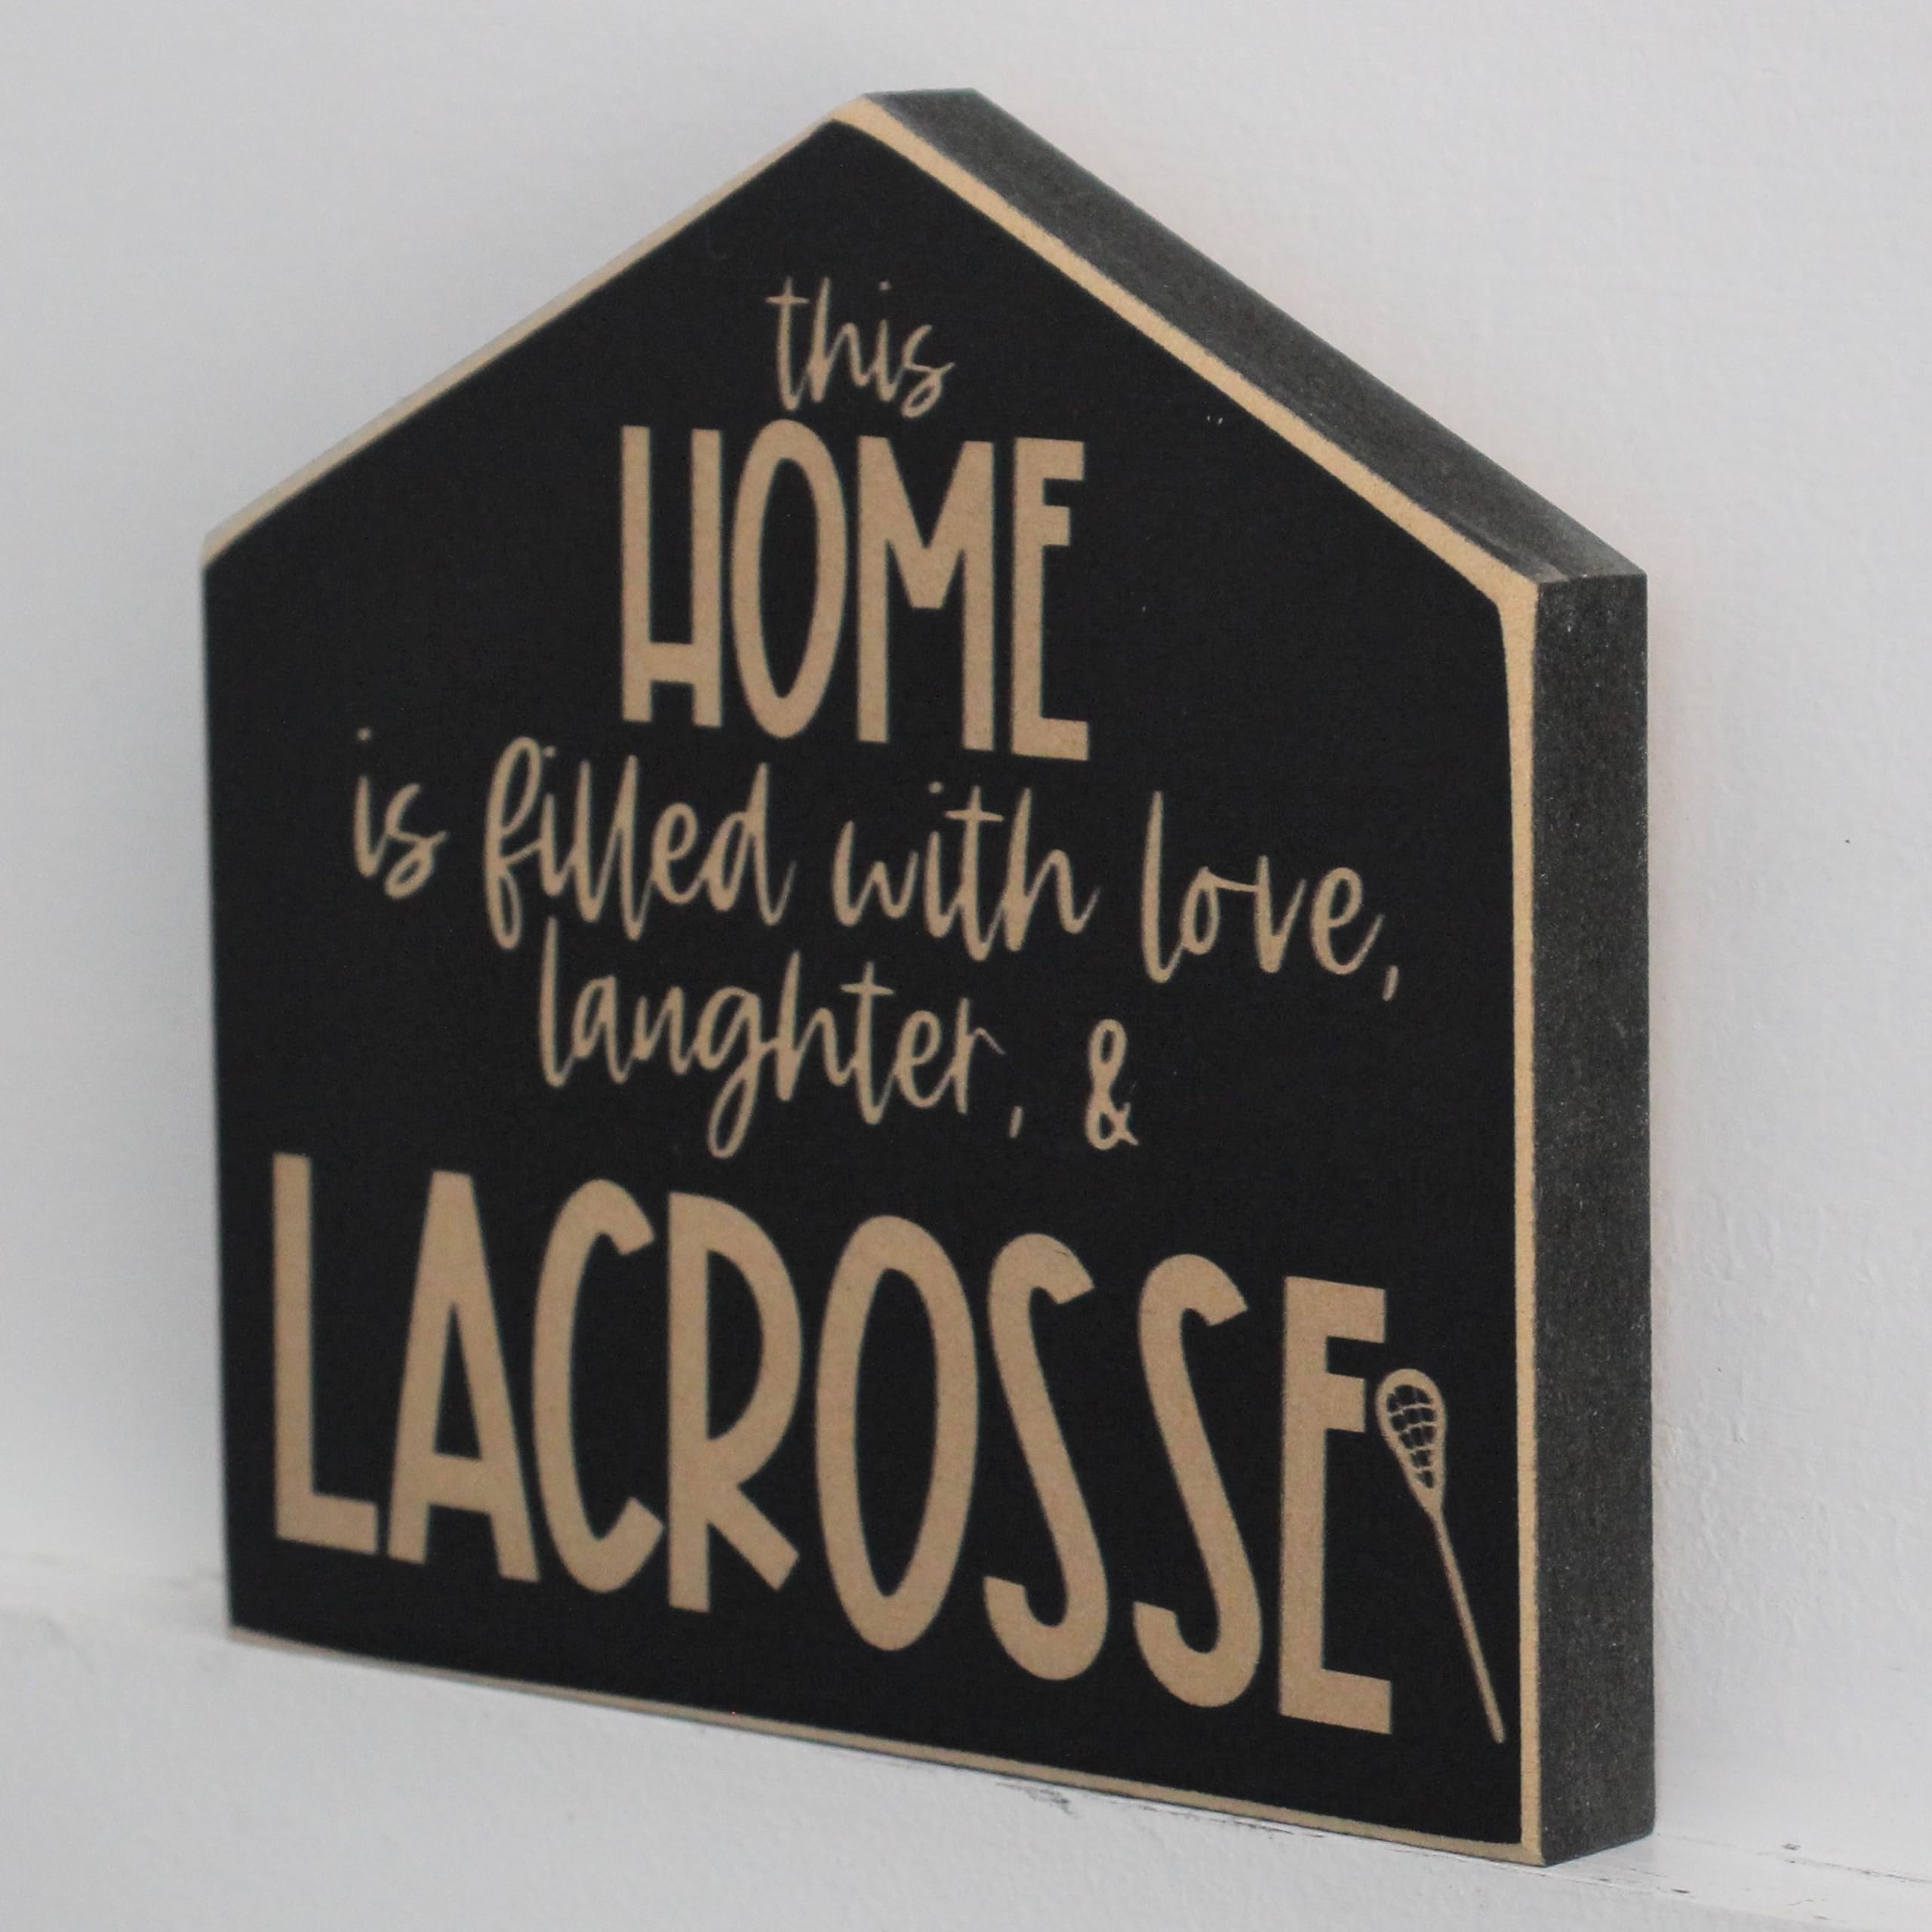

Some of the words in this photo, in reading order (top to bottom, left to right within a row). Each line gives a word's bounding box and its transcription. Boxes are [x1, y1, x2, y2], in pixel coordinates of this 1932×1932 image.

[766, 277, 955, 419] this
[620, 419, 1089, 761] HOME
[353, 728, 446, 899] is
[484, 737, 791, 949] filled
[832, 781, 1098, 961] with
[1140, 791, 1400, 1002] love,
[539, 917, 1023, 1158] laughter,
[1084, 1018, 1140, 1152] &
[272, 1153, 1392, 1734] LACROSSE
